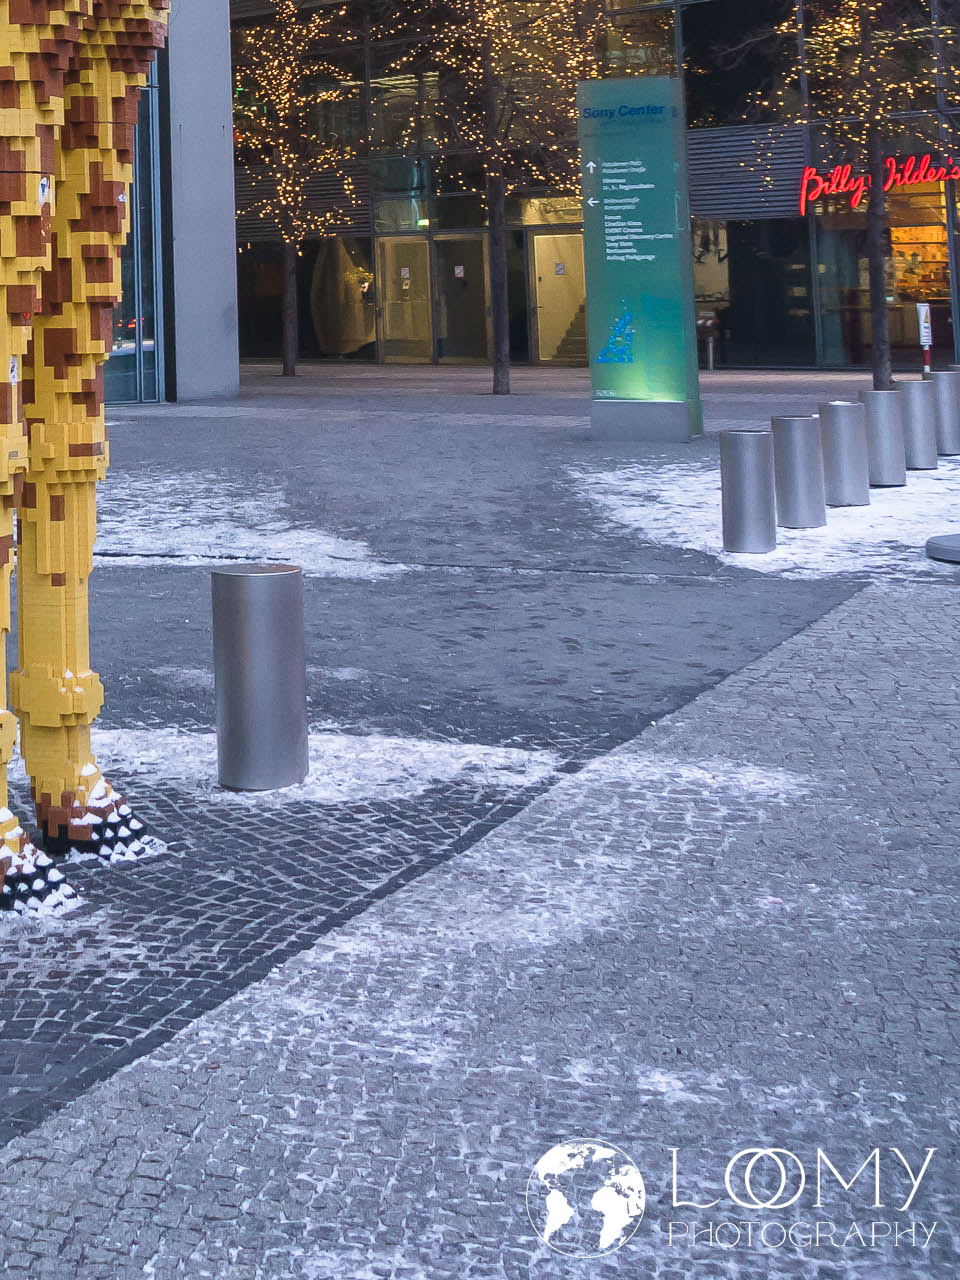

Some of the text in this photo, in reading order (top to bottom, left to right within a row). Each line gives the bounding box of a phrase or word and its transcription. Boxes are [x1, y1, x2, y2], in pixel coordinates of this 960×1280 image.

[583, 104, 664, 120] Sony Center
[800, 163, 869, 217] Billy
